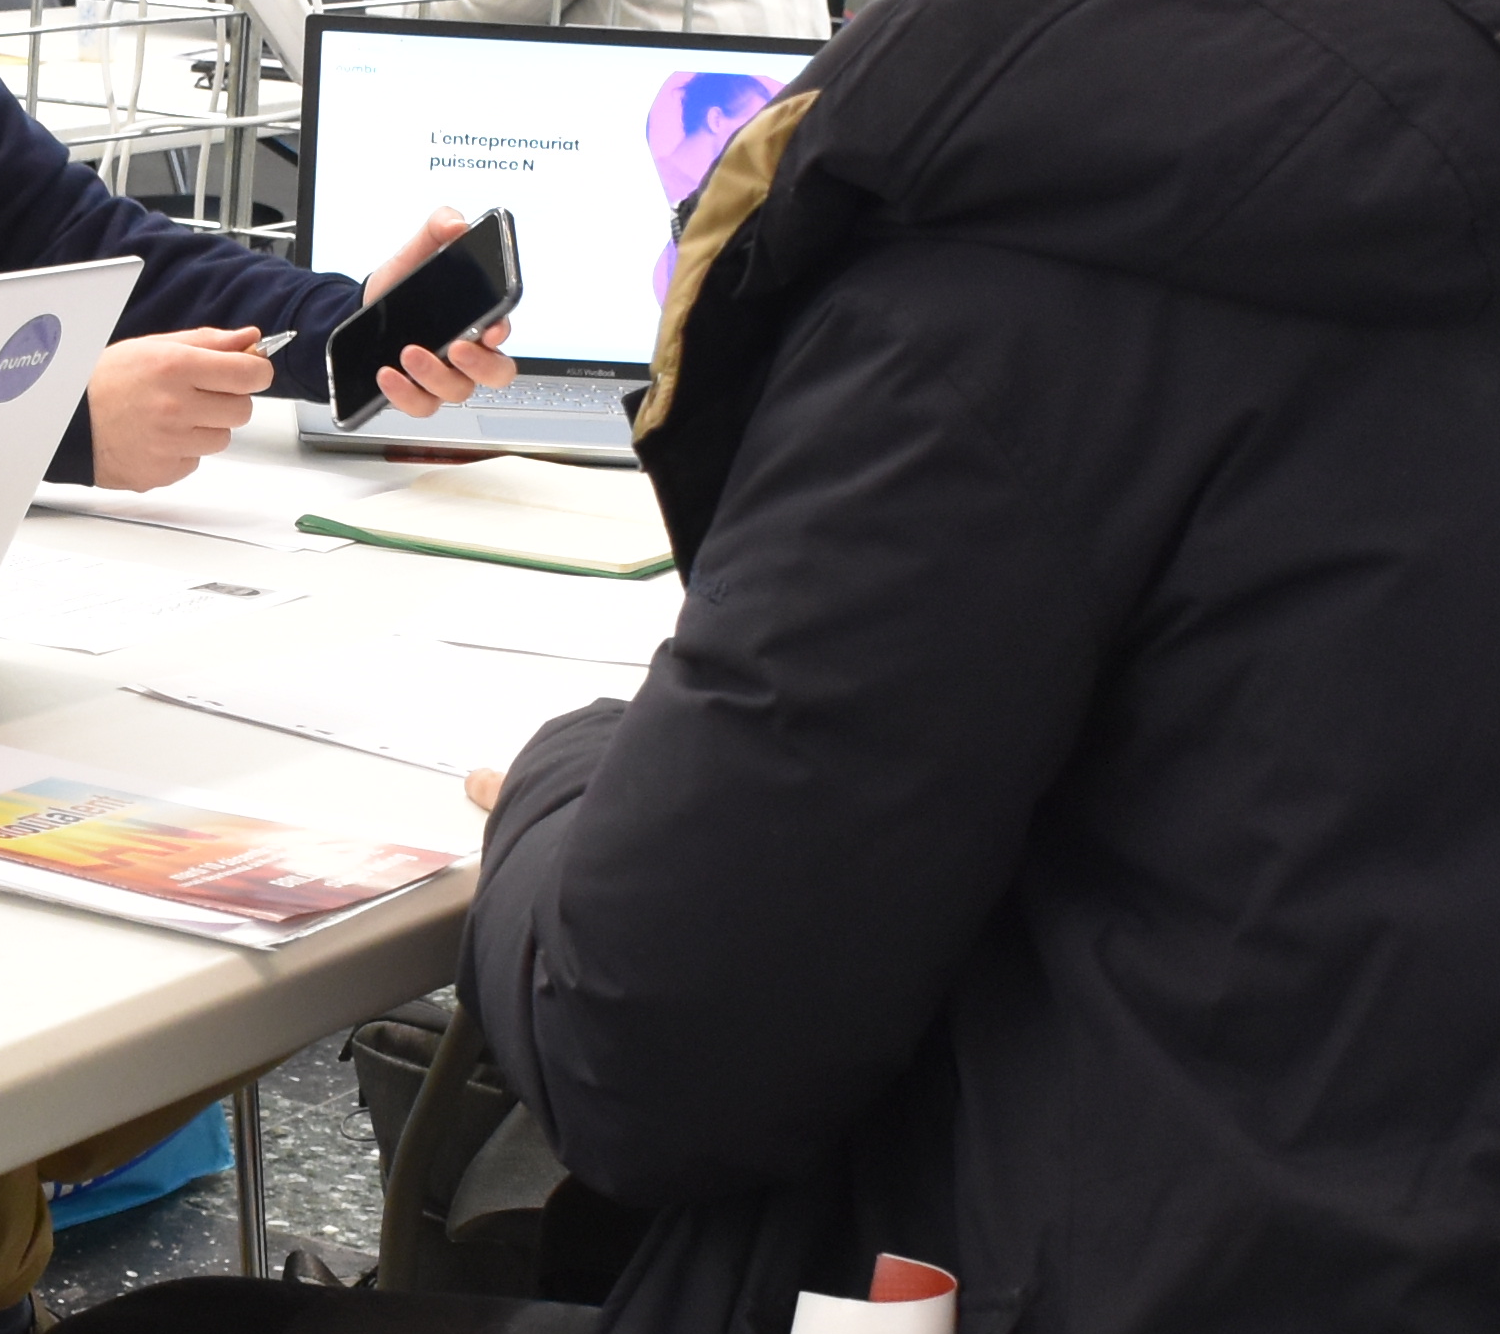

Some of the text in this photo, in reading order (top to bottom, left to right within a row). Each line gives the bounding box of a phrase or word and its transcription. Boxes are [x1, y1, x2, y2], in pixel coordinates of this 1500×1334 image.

[430, 129, 580, 151] L'entrepreneuriat
[430, 154, 534, 171] puissance N
